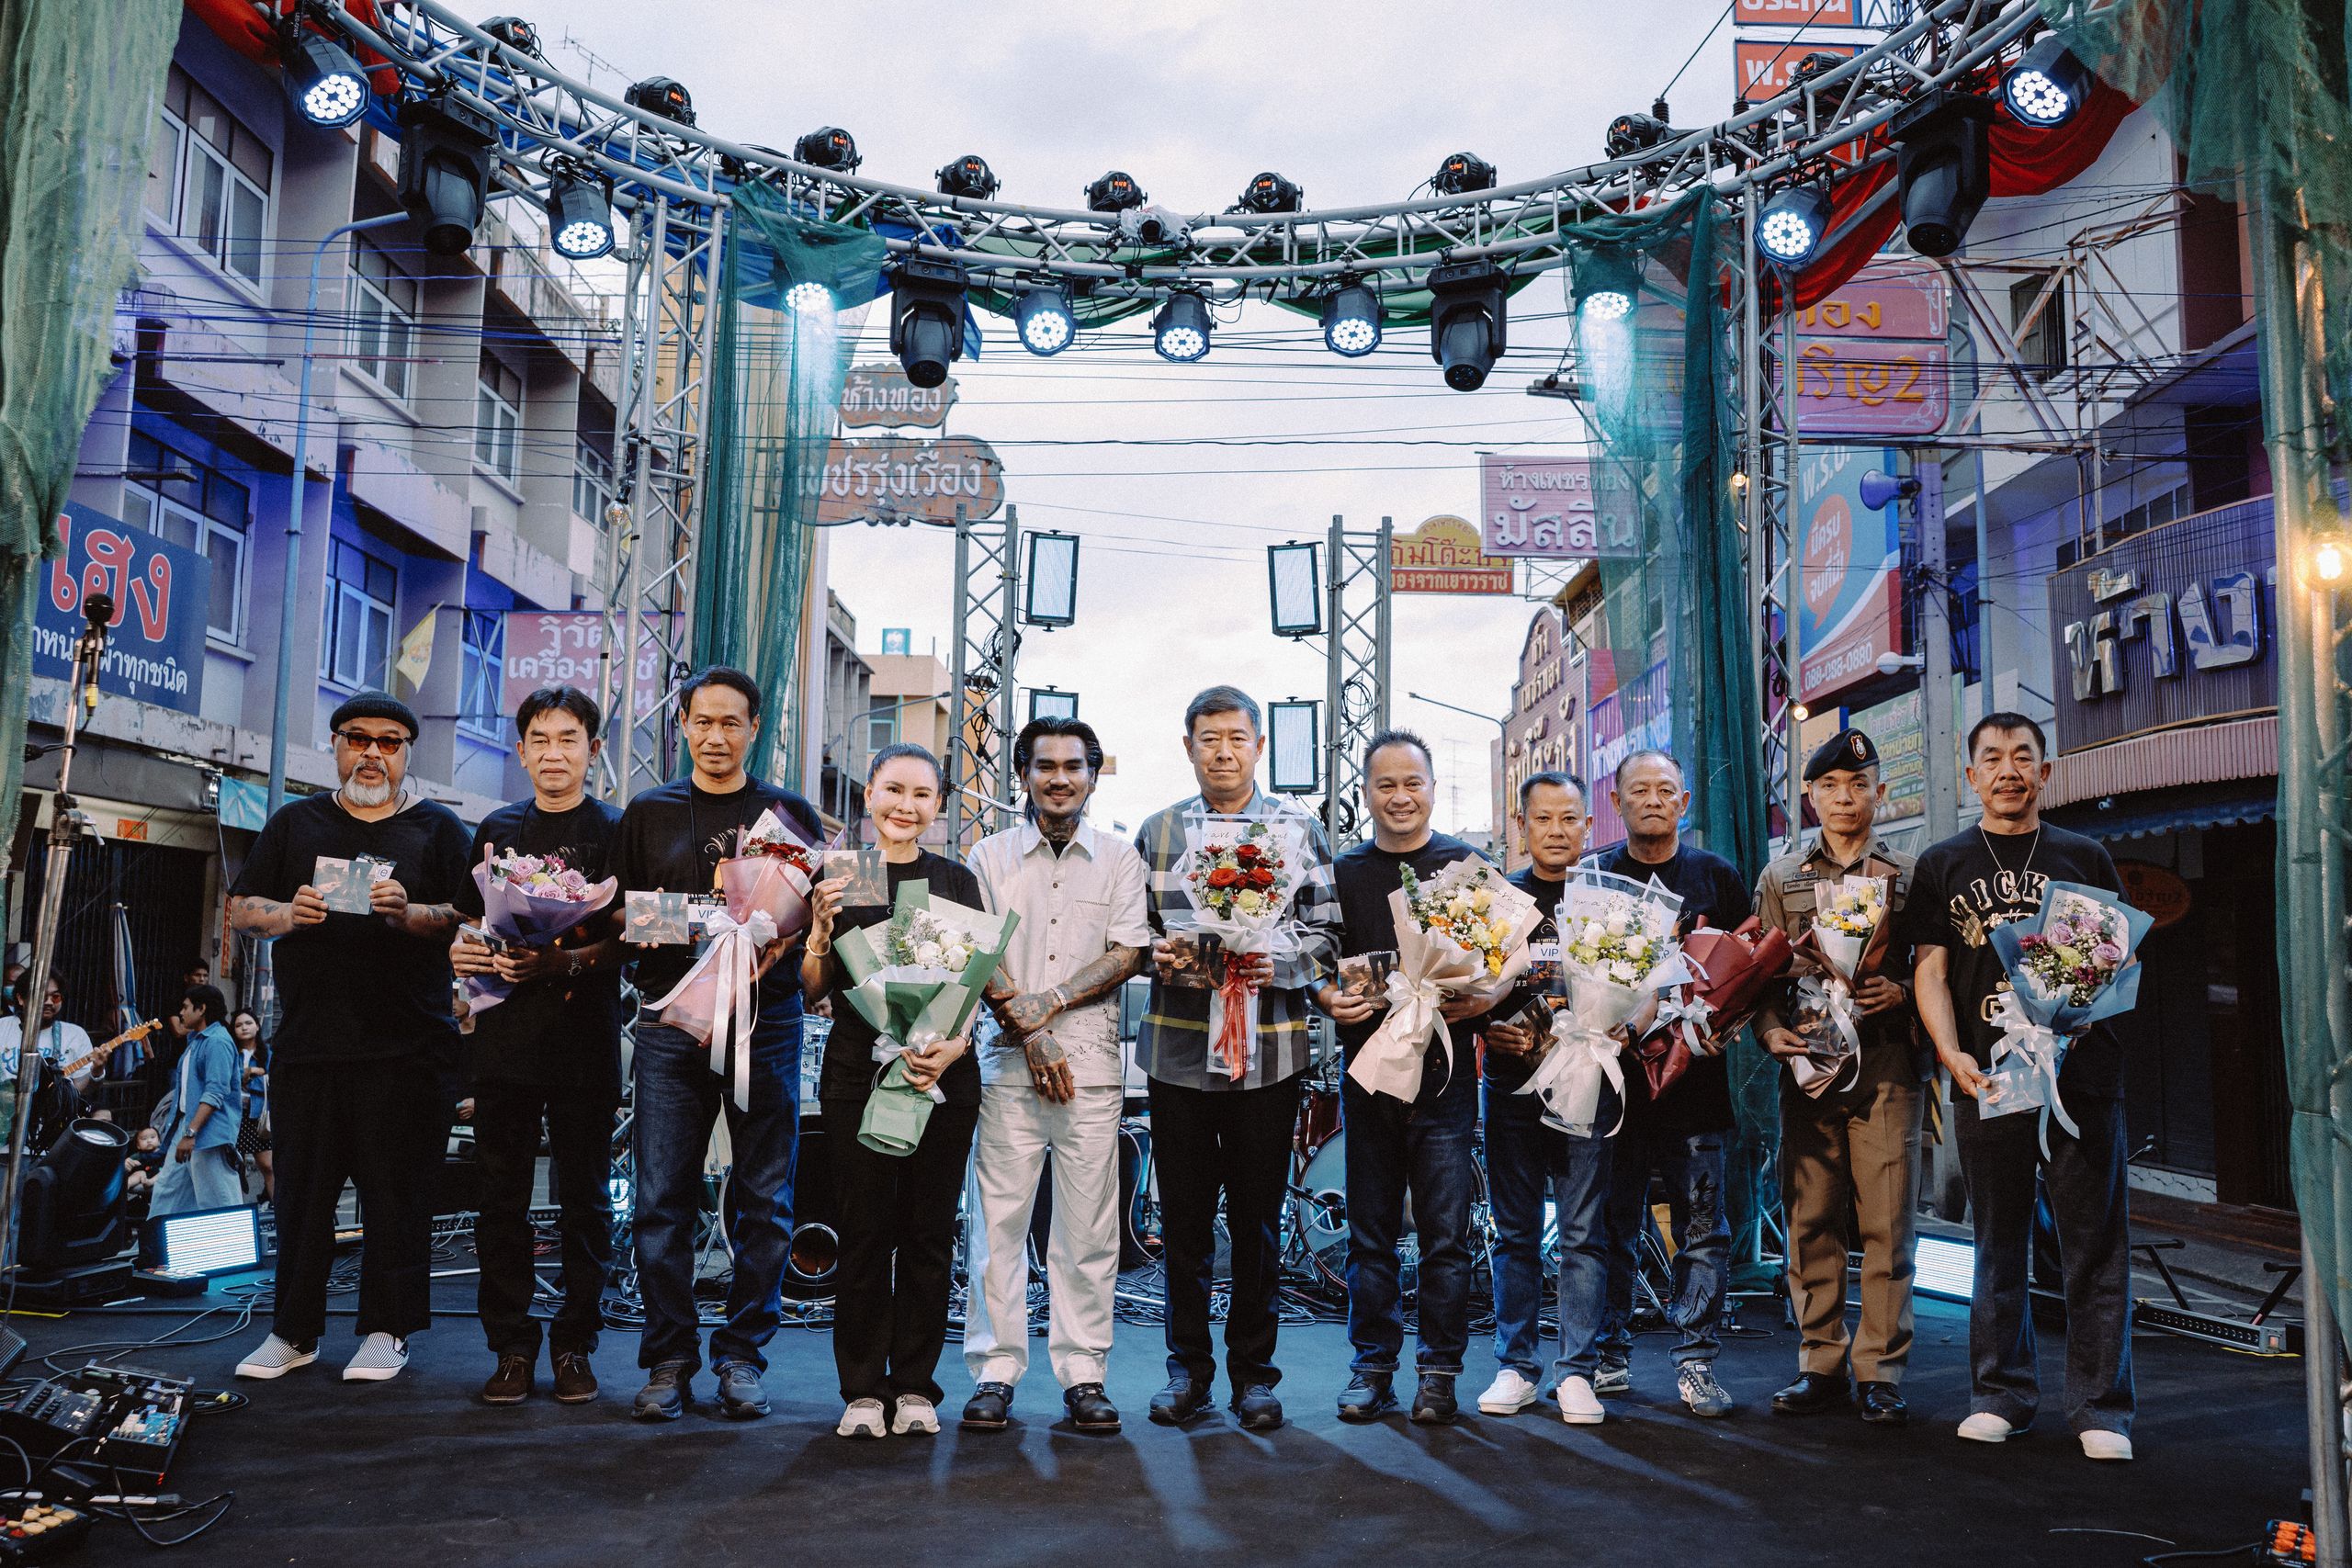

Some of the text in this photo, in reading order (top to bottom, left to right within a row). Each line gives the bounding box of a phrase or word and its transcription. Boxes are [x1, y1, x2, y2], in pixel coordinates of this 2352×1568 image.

[842, 376, 942, 412] ห้างทอง
[2064, 566, 2276, 702] ห้าง
[1540, 947, 1559, 957] VIP
